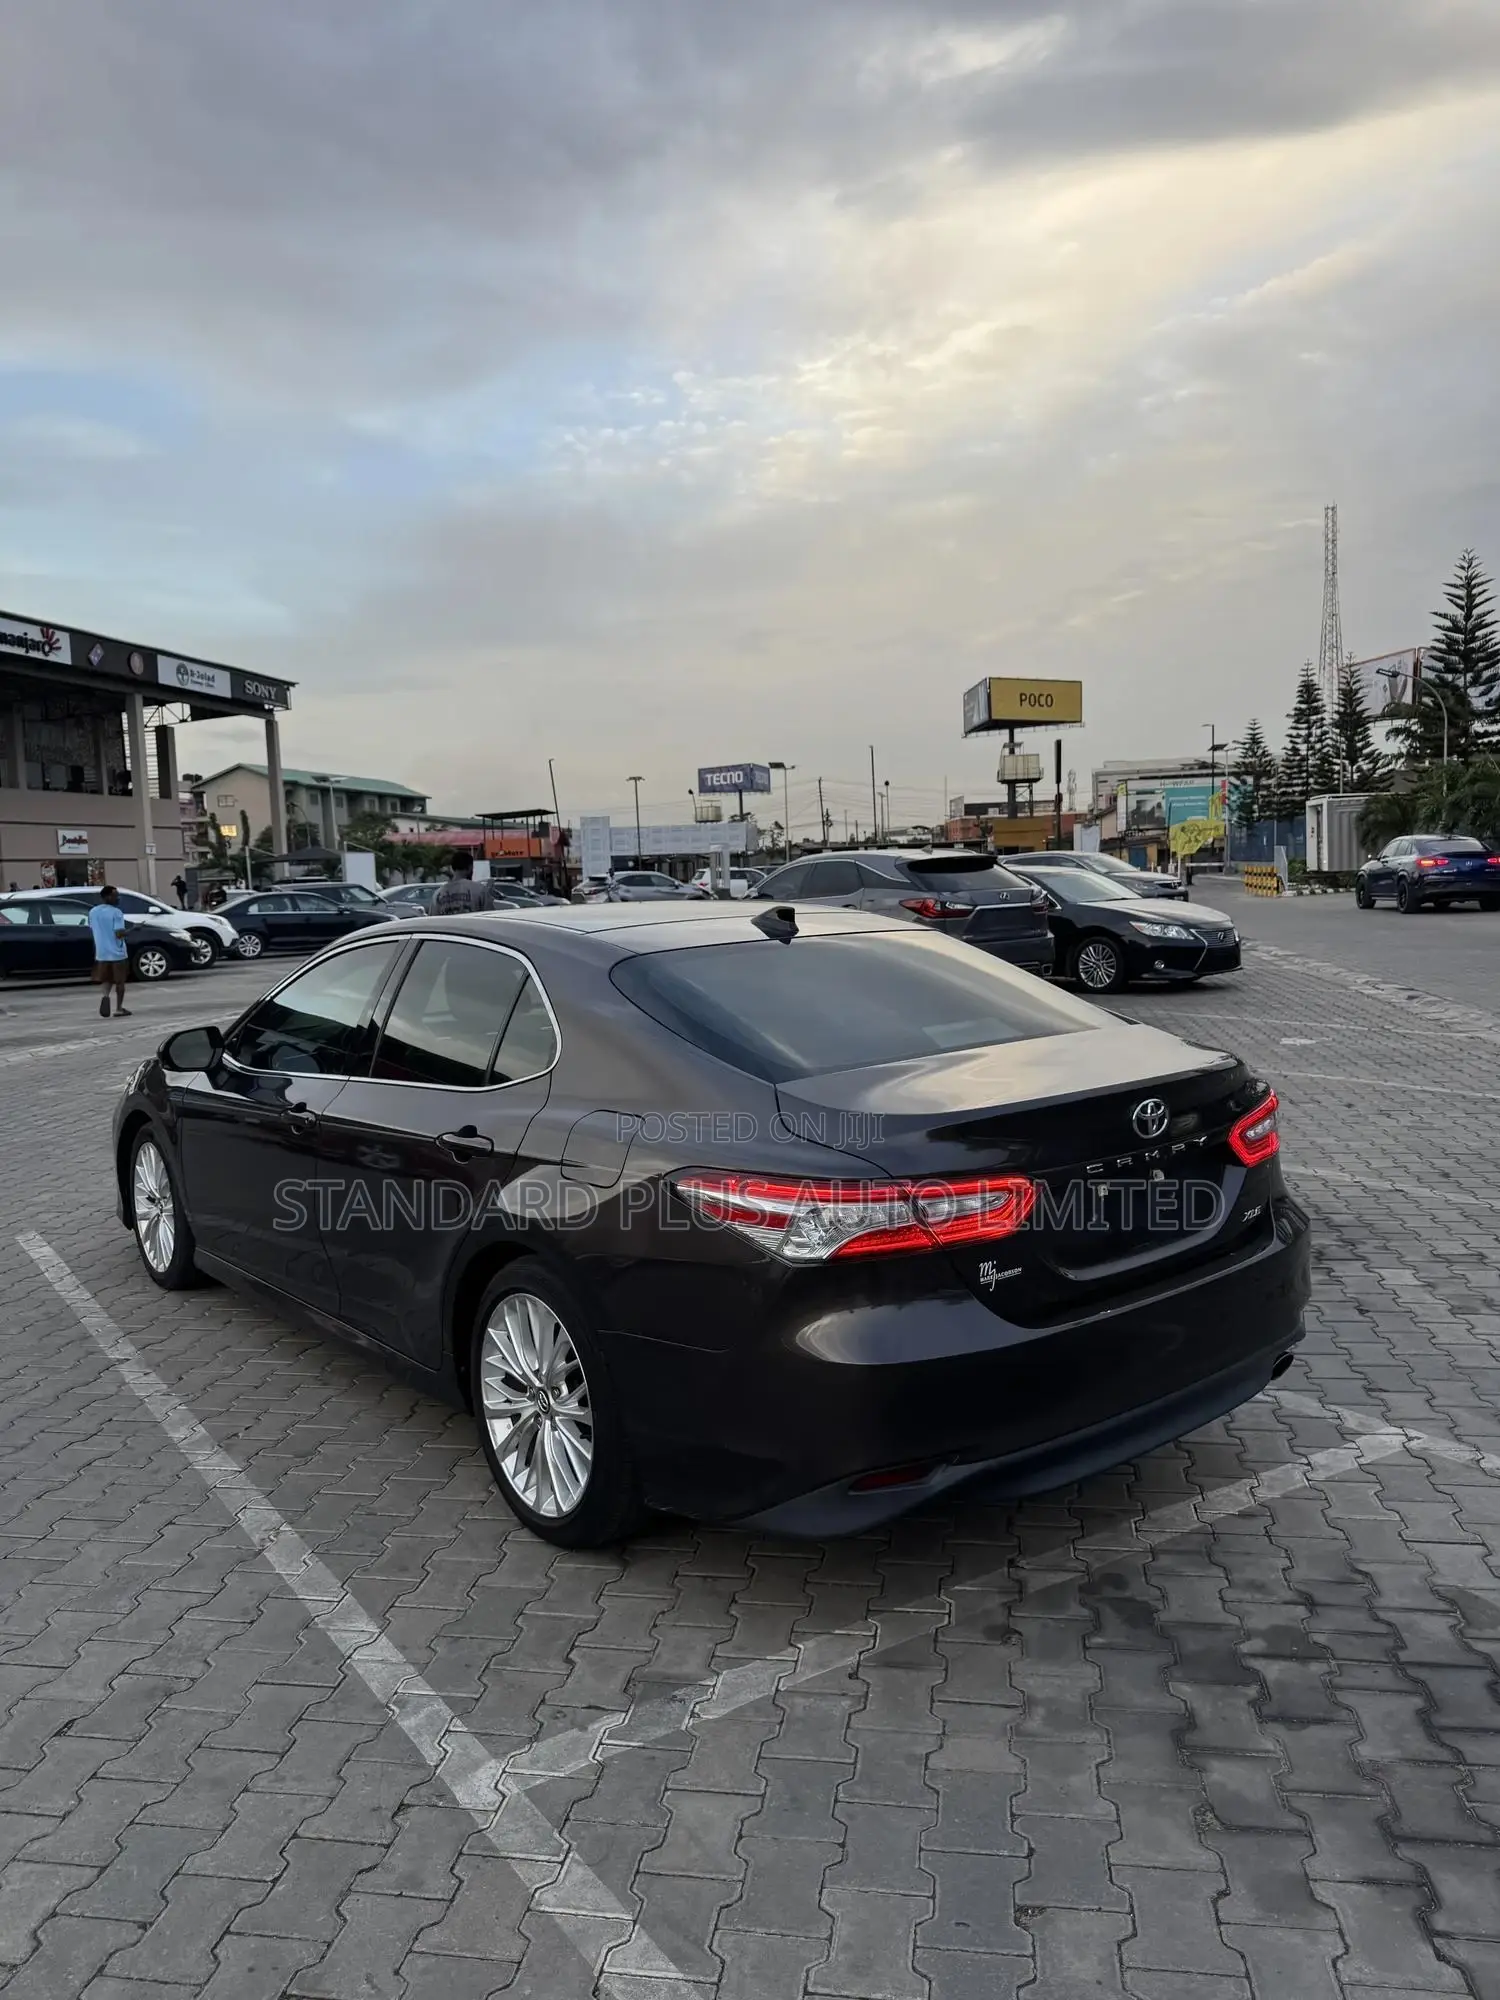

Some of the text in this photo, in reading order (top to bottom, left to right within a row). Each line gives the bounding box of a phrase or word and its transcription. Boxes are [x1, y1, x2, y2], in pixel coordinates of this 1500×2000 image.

[244, 680, 277, 699] SONY
[1019, 692, 1054, 708] POCO
[705, 771, 744, 787] TECNO
